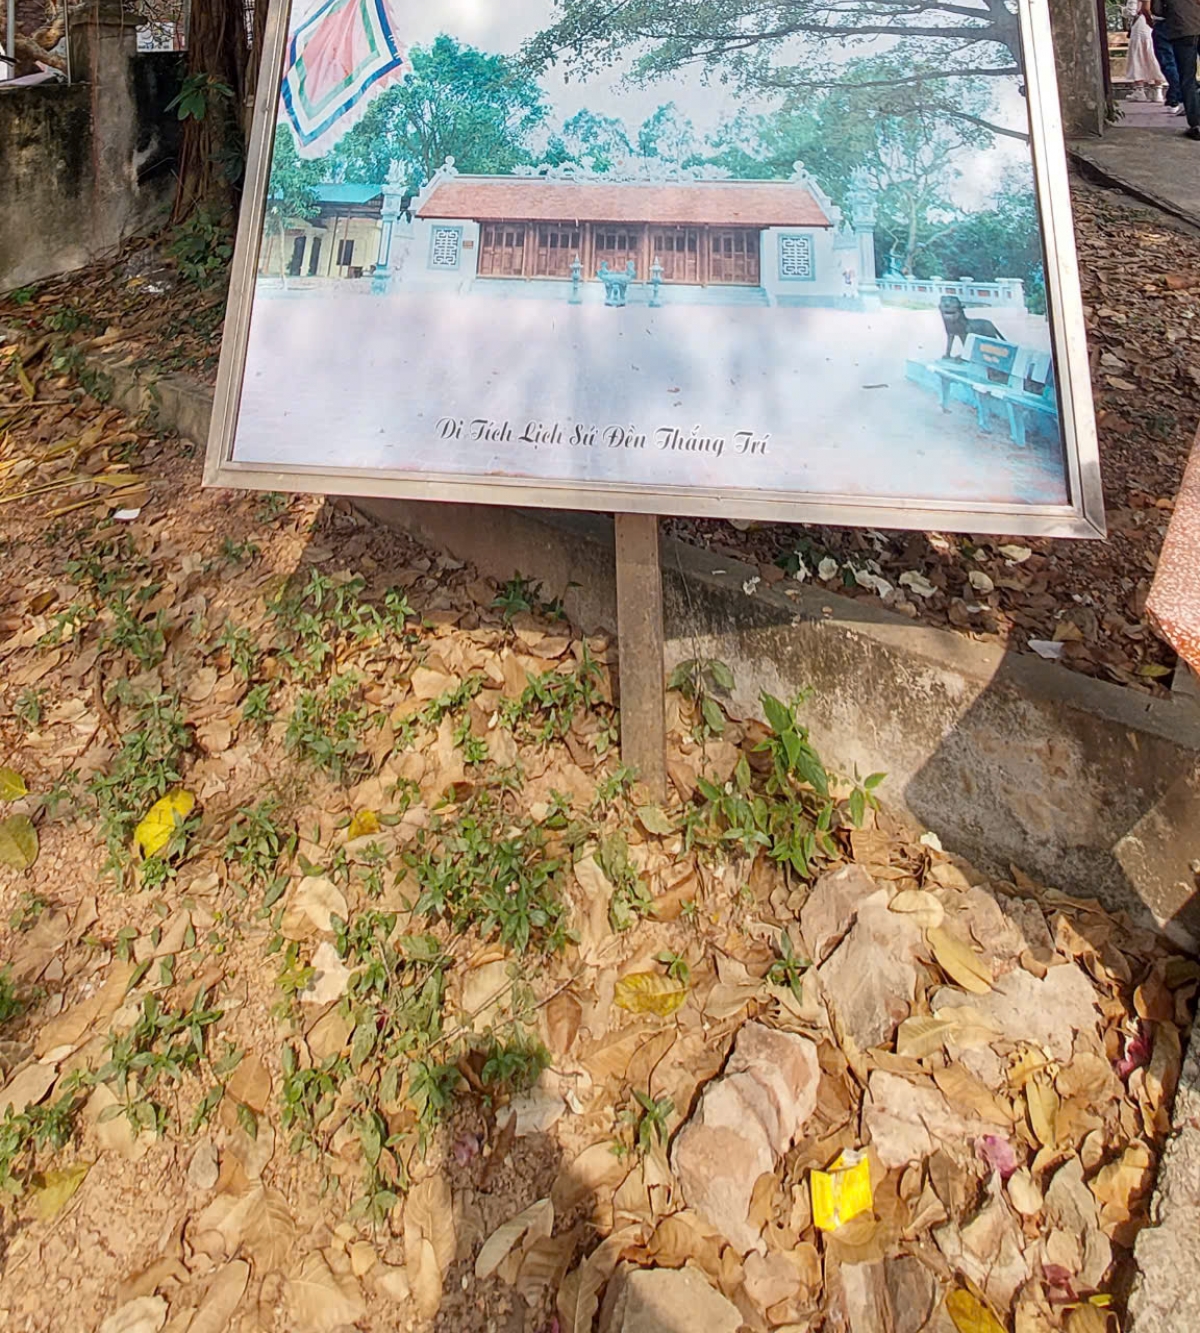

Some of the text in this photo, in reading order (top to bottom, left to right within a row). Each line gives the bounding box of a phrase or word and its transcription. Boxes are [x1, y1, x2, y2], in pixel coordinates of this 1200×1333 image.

[435, 418, 463, 439] Di
[470, 419, 511, 442] Tích
[518, 421, 562, 449] Lịch
[734, 431, 769, 454] Trí
